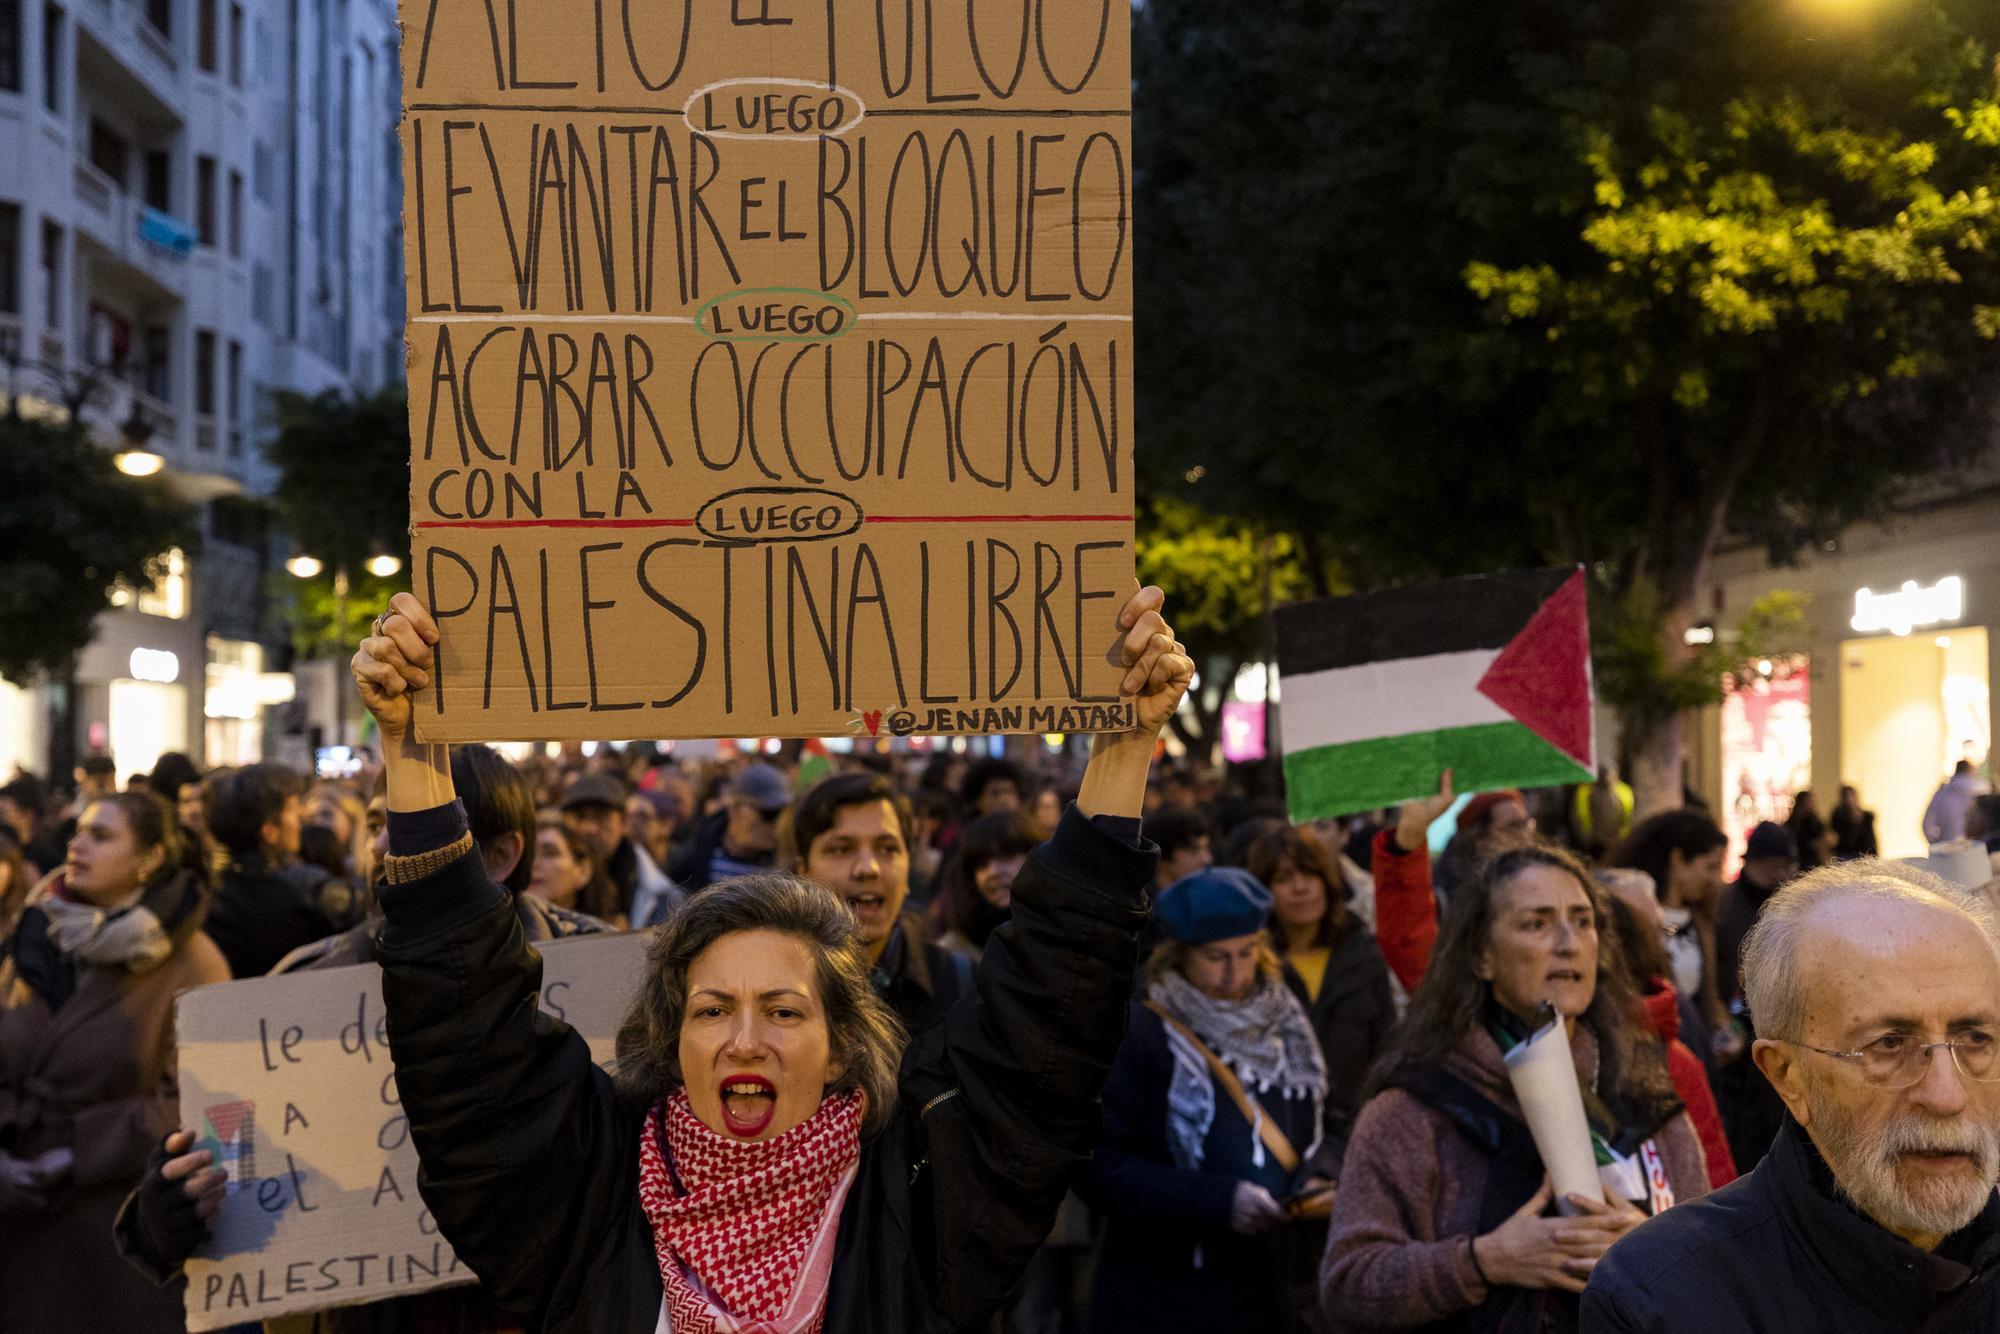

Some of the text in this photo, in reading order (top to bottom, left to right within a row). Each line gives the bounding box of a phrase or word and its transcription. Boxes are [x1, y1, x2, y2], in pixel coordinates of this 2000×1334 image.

[704, 92, 844, 133] LUEGO
[413, 118, 1126, 313] LEVANTAR EL BLOQUEO
[711, 303, 846, 336] LUEGO
[423, 321, 1119, 493] ACABAR OCCUPACIÓN
[427, 467, 653, 520] CON LA
[714, 505, 844, 534] LUEGO
[427, 537, 1126, 717] PALESTINA LIBRE
[887, 702, 1134, 737] @JENAN MATARI
[258, 1016, 304, 1071] le
